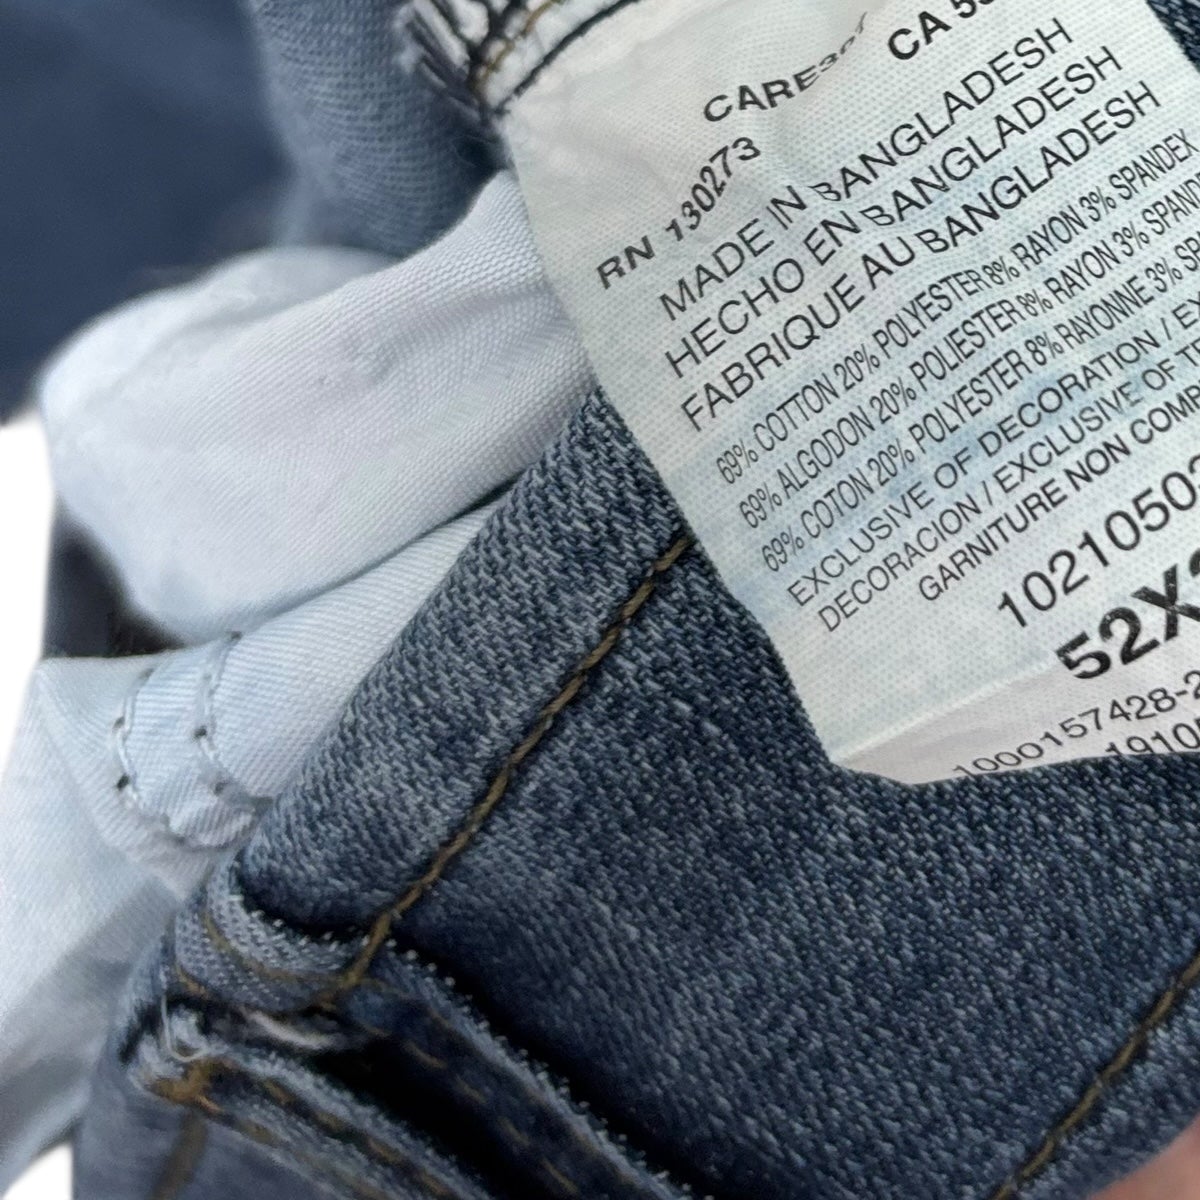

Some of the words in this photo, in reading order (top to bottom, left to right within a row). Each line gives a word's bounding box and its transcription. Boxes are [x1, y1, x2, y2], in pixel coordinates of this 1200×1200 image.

[659, 218, 775, 321] MADE
[766, 185, 807, 230] IN
[808, 18, 1073, 201] BANGLADESH
[887, 11, 952, 60] CA
[596, 235, 655, 289] RN
[665, 137, 761, 241] 130273
[664, 258, 805, 378] HECHO
[803, 210, 861, 266] EN
[860, 45, 1122, 226] BANGLADESH
[680, 273, 865, 432] FABRIQUE
[860, 236, 916, 290] AU
[915, 80, 1161, 252] BANGLADESH
[716, 439, 759, 484] 69%
[753, 374, 837, 451] COTTON
[833, 343, 880, 392] 20%
[872, 266, 989, 359] POLYESTER
[983, 256, 1020, 286] 8%
[1011, 205, 1088, 271] RAYON
[1078, 186, 1116, 222] 3%
[1108, 128, 1199, 200] SPANDEX
[739, 482, 782, 529] 69%
[777, 405, 875, 499] ALGODON
[869, 377, 917, 423] 20%
[909, 297, 1024, 391] POLIESTER
[1016, 289, 1053, 316] 8%
[1044, 240, 1121, 303] RAYON
[1112, 221, 1150, 257] 3%
[761, 526, 804, 572] 69%
[800, 467, 875, 538] COTON
[867, 437, 915, 486] 20%
[908, 348, 1032, 452] POLYESTER
[1024, 331, 1065, 366] 8%
[1053, 275, 1155, 348] RAYONNE
[1145, 257, 1183, 293] 3%
[787, 480, 935, 606] EXCLUSIVE
[933, 446, 973, 489] OF
[977, 330, 1161, 457] DECORATION
[1159, 317, 1172, 341] /
[818, 493, 981, 632] DECORACION
[981, 480, 993, 506] /
[993, 381, 1144, 494] EXCLUSIVE
[1141, 357, 1177, 391] OF
[918, 478, 1068, 600] GARNITURE
[1063, 434, 1132, 492] NON
